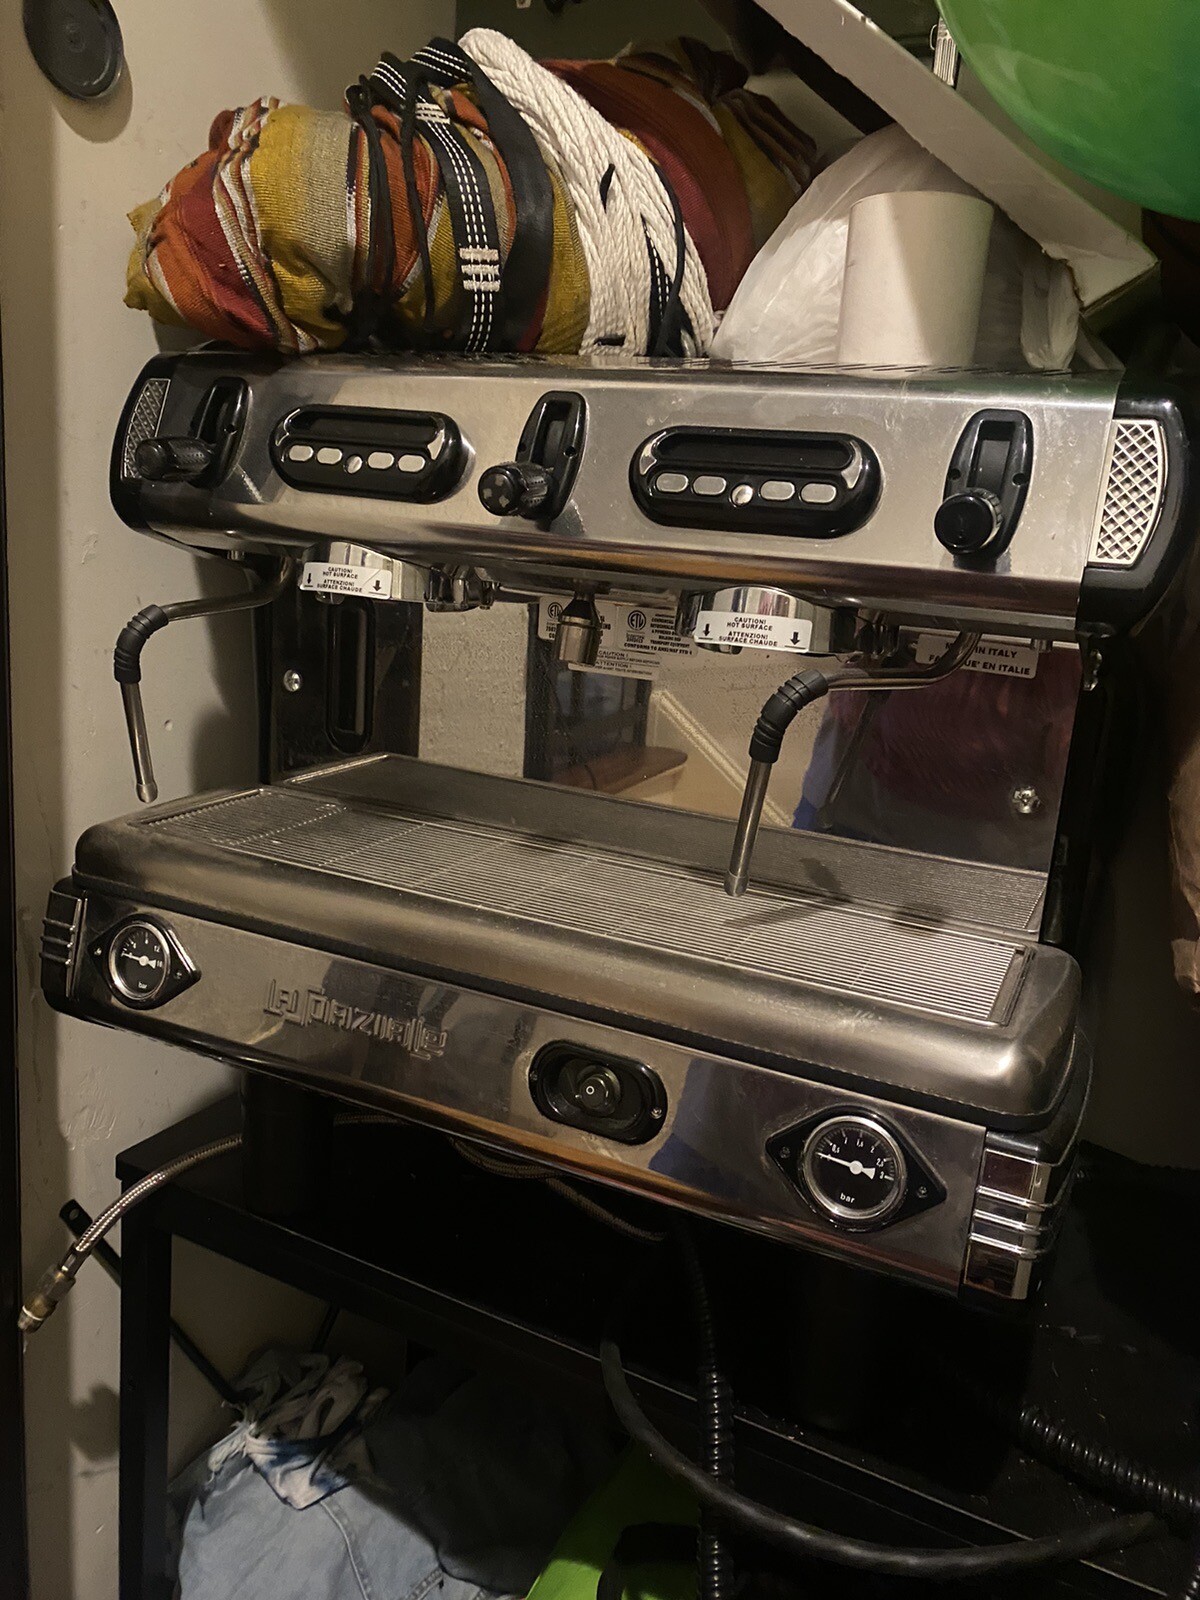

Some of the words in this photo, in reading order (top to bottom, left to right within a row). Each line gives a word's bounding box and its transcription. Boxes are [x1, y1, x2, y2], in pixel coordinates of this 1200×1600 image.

[333, 572, 359, 580] SURFACE
[339, 585, 363, 593] CHAUDE
[741, 623, 773, 632] SURFACE
[719, 635, 747, 644] SURFACE
[748, 638, 778, 647] CHAUDE
[988, 648, 1018, 659] ITALY
[982, 661, 996, 671] EN
[998, 664, 1031, 676] ITALIE
[840, 1192, 855, 1204] bar
